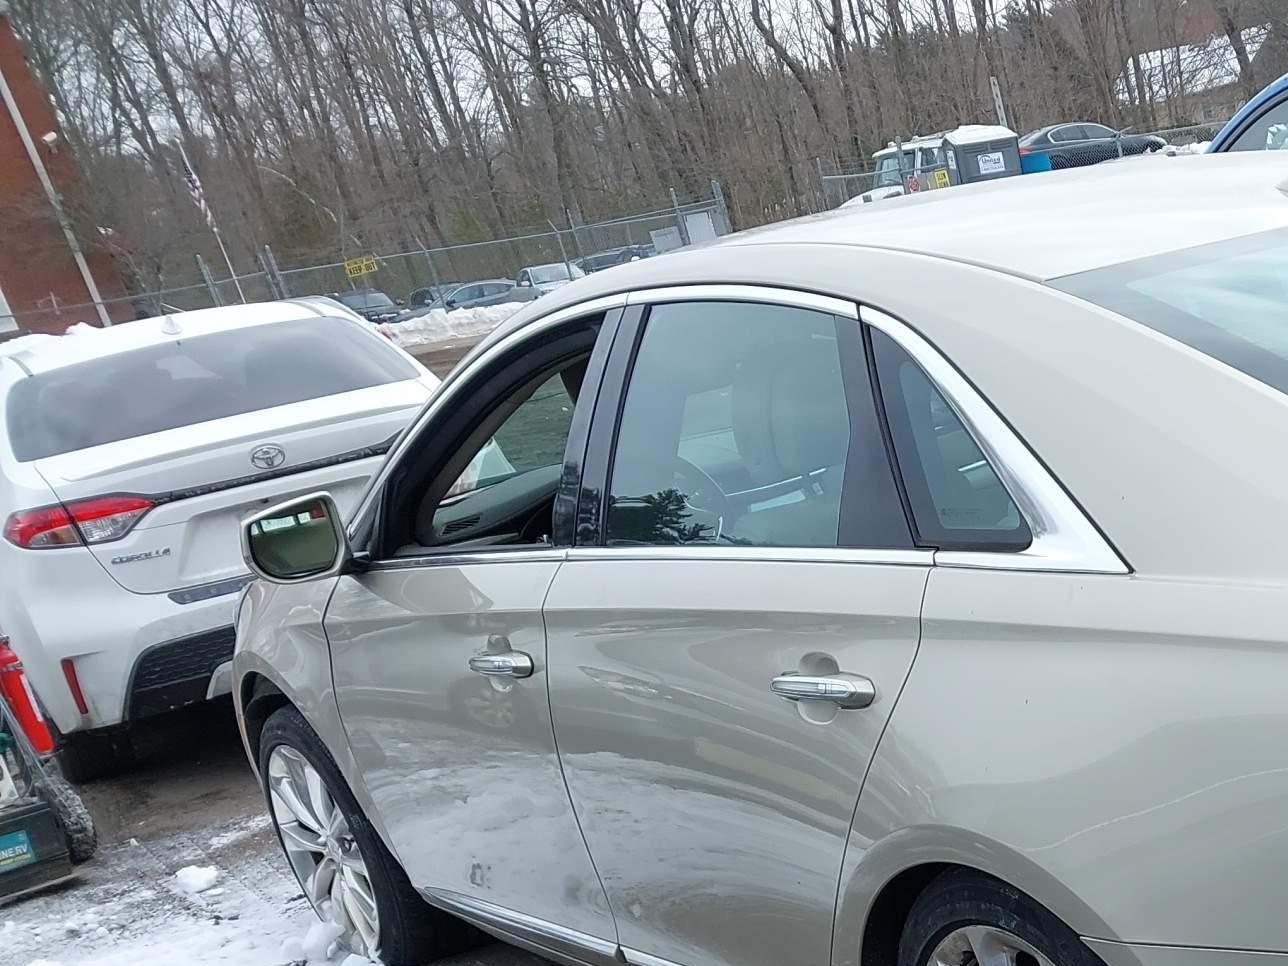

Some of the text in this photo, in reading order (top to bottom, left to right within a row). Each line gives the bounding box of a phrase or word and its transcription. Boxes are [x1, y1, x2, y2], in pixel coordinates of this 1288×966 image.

[348, 264, 362, 275] KEEP
[364, 261, 377, 272] OUT
[111, 547, 170, 564] COROLLA
